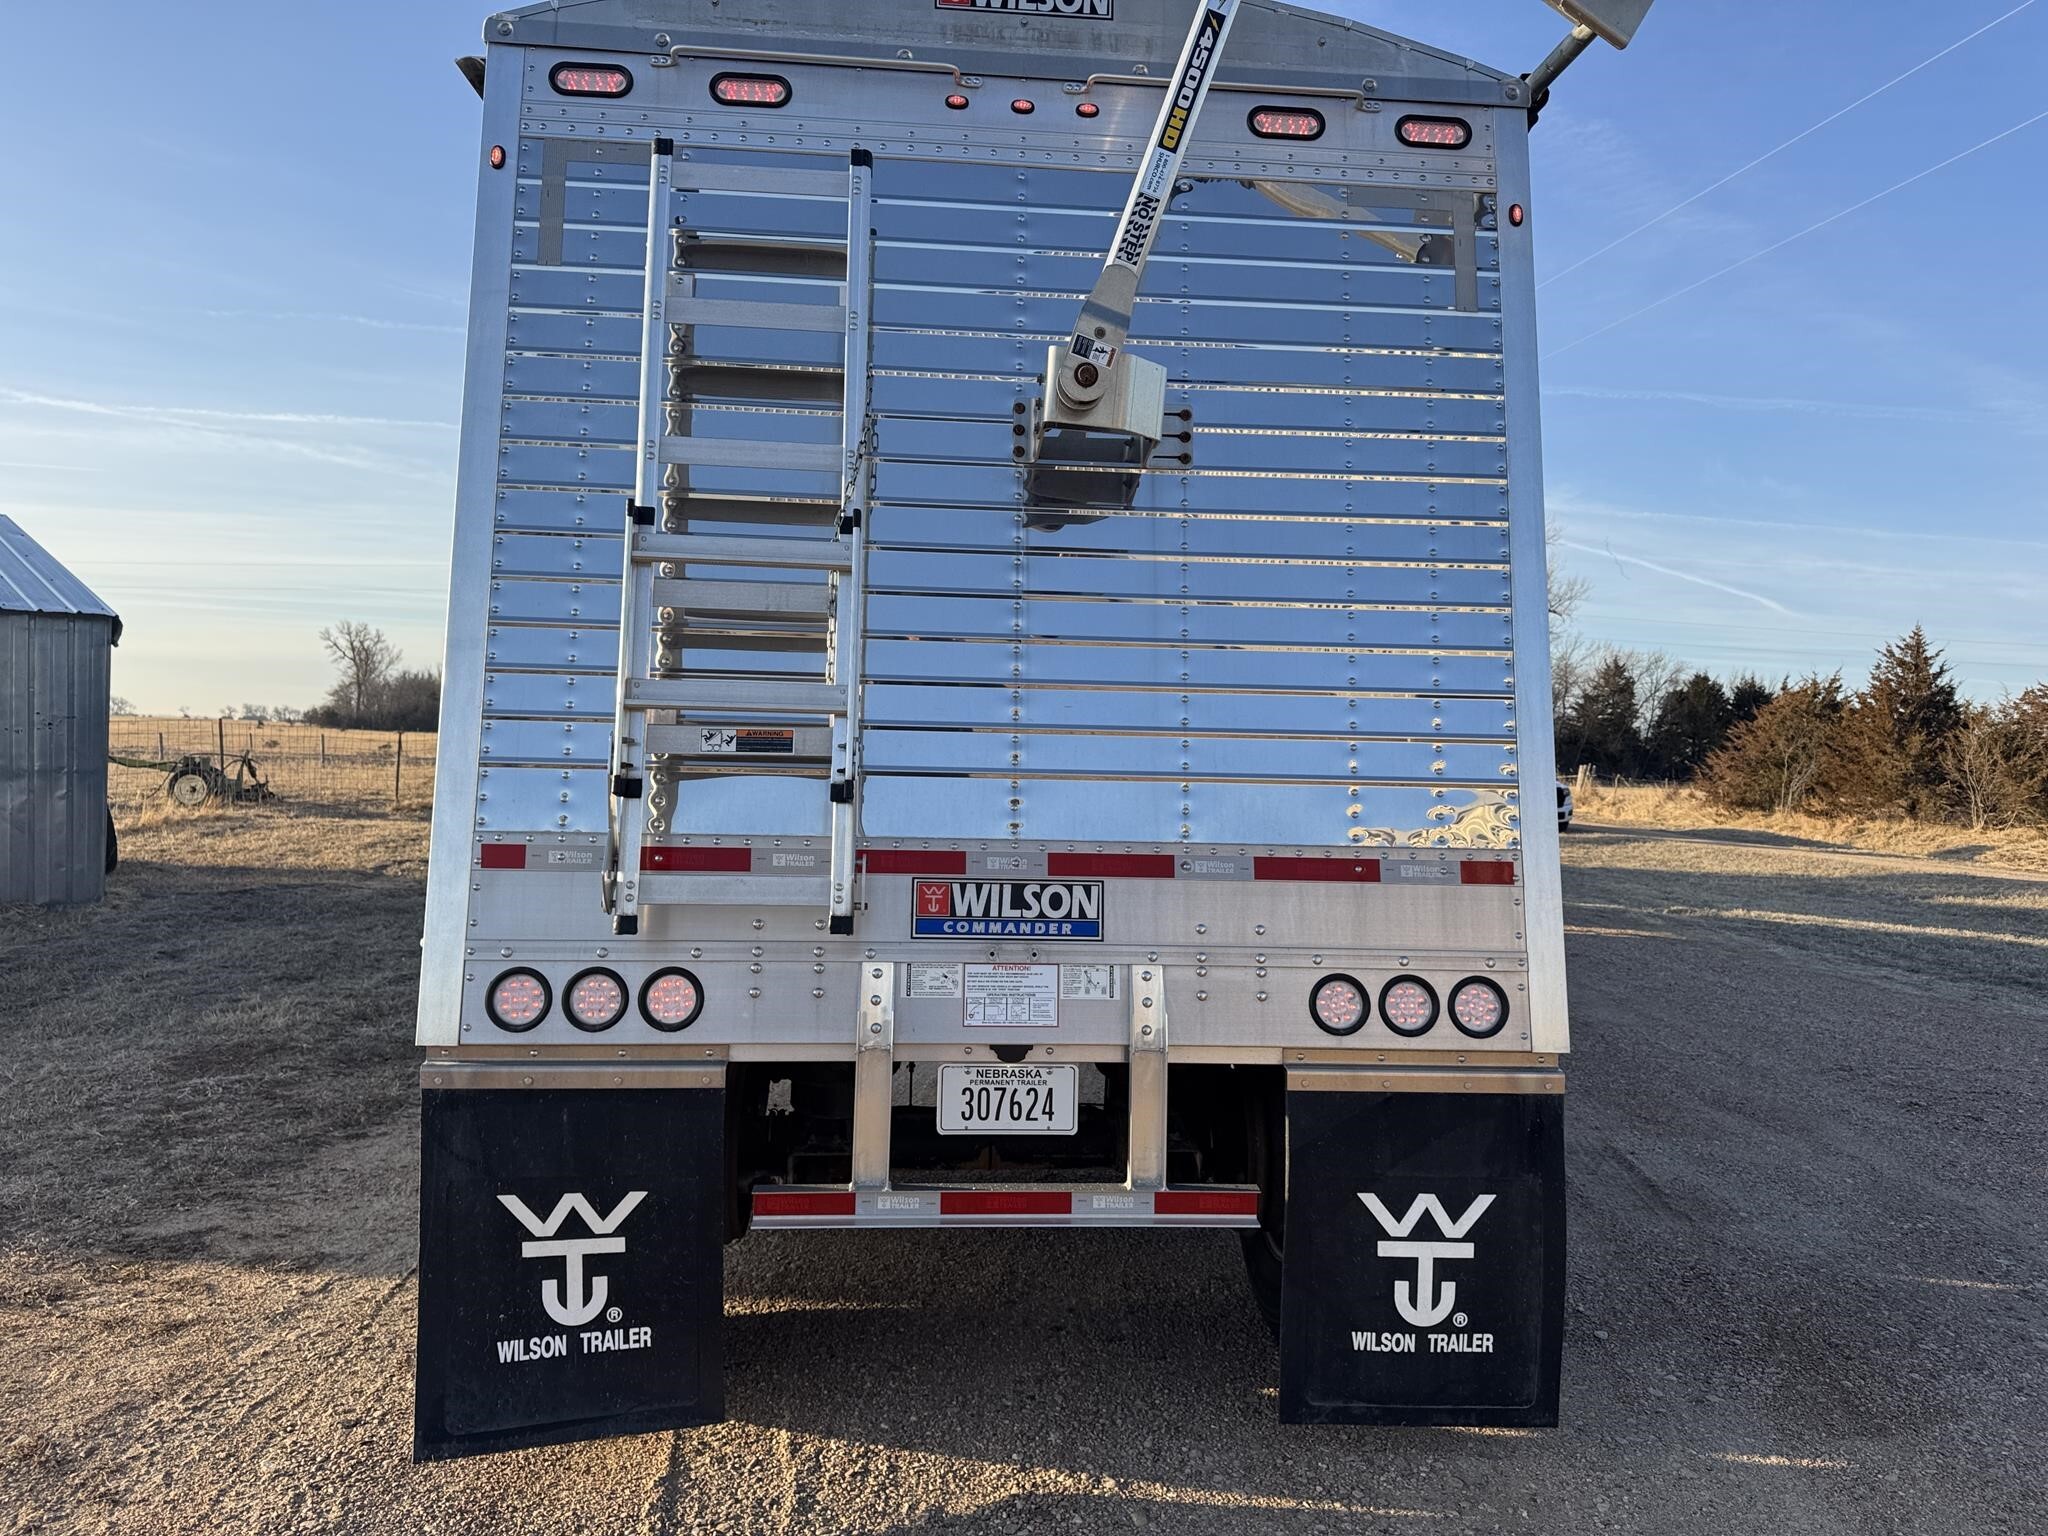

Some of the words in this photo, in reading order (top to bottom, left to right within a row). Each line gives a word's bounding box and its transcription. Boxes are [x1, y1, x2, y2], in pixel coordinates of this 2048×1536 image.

[1162, 26, 1214, 149] 4500HD
[1138, 194, 1155, 219] NO
[1124, 220, 1145, 262] STEP
[951, 883, 1099, 919] WILSON
[943, 921, 1072, 935] COMMANDER
[976, 1069, 1042, 1079] NEBRASKA
[961, 1087, 1055, 1121] 307624
[497, 1334, 567, 1364] WILSON
[579, 1326, 652, 1354] TRAILER
[1351, 1331, 1416, 1353] WILSON
[1427, 1333, 1494, 1353] TRAILER
